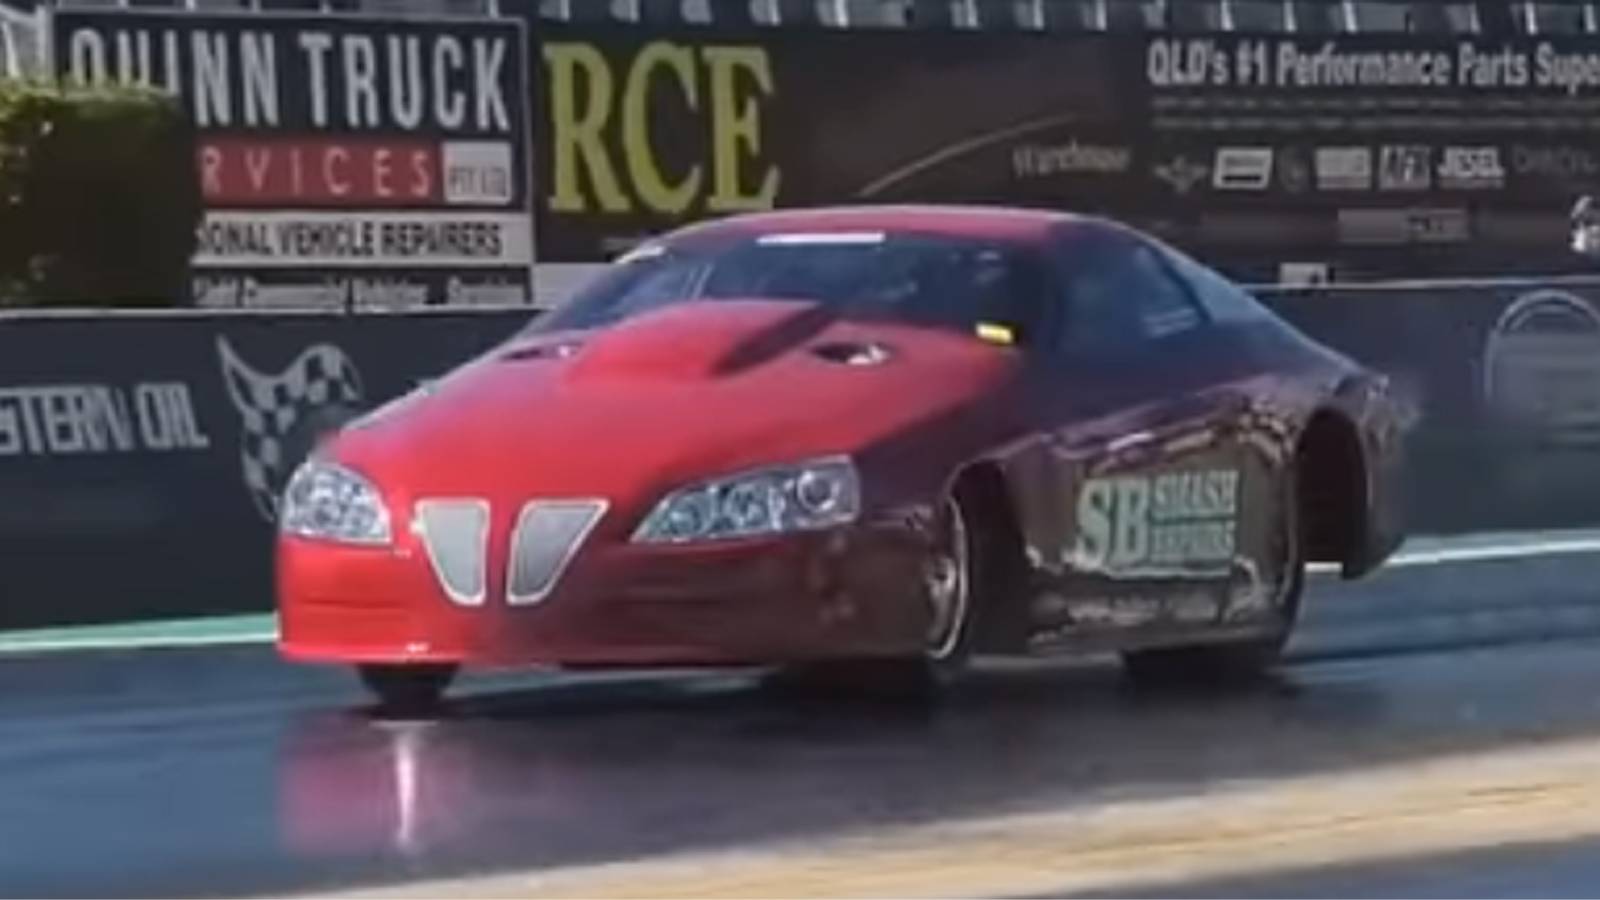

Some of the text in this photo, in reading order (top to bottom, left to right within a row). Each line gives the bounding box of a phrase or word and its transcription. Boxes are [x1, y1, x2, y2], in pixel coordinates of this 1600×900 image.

[301, 32, 511, 131] TRUCK
[1276, 41, 1451, 86] Performance
[1457, 42, 1528, 86] Parts
[542, 41, 781, 213] RCE
[275, 220, 375, 257] VEHICLE
[381, 220, 501, 256] REPAIRERS
[136, 382, 209, 449] OIL
[1076, 477, 1149, 569] SB
